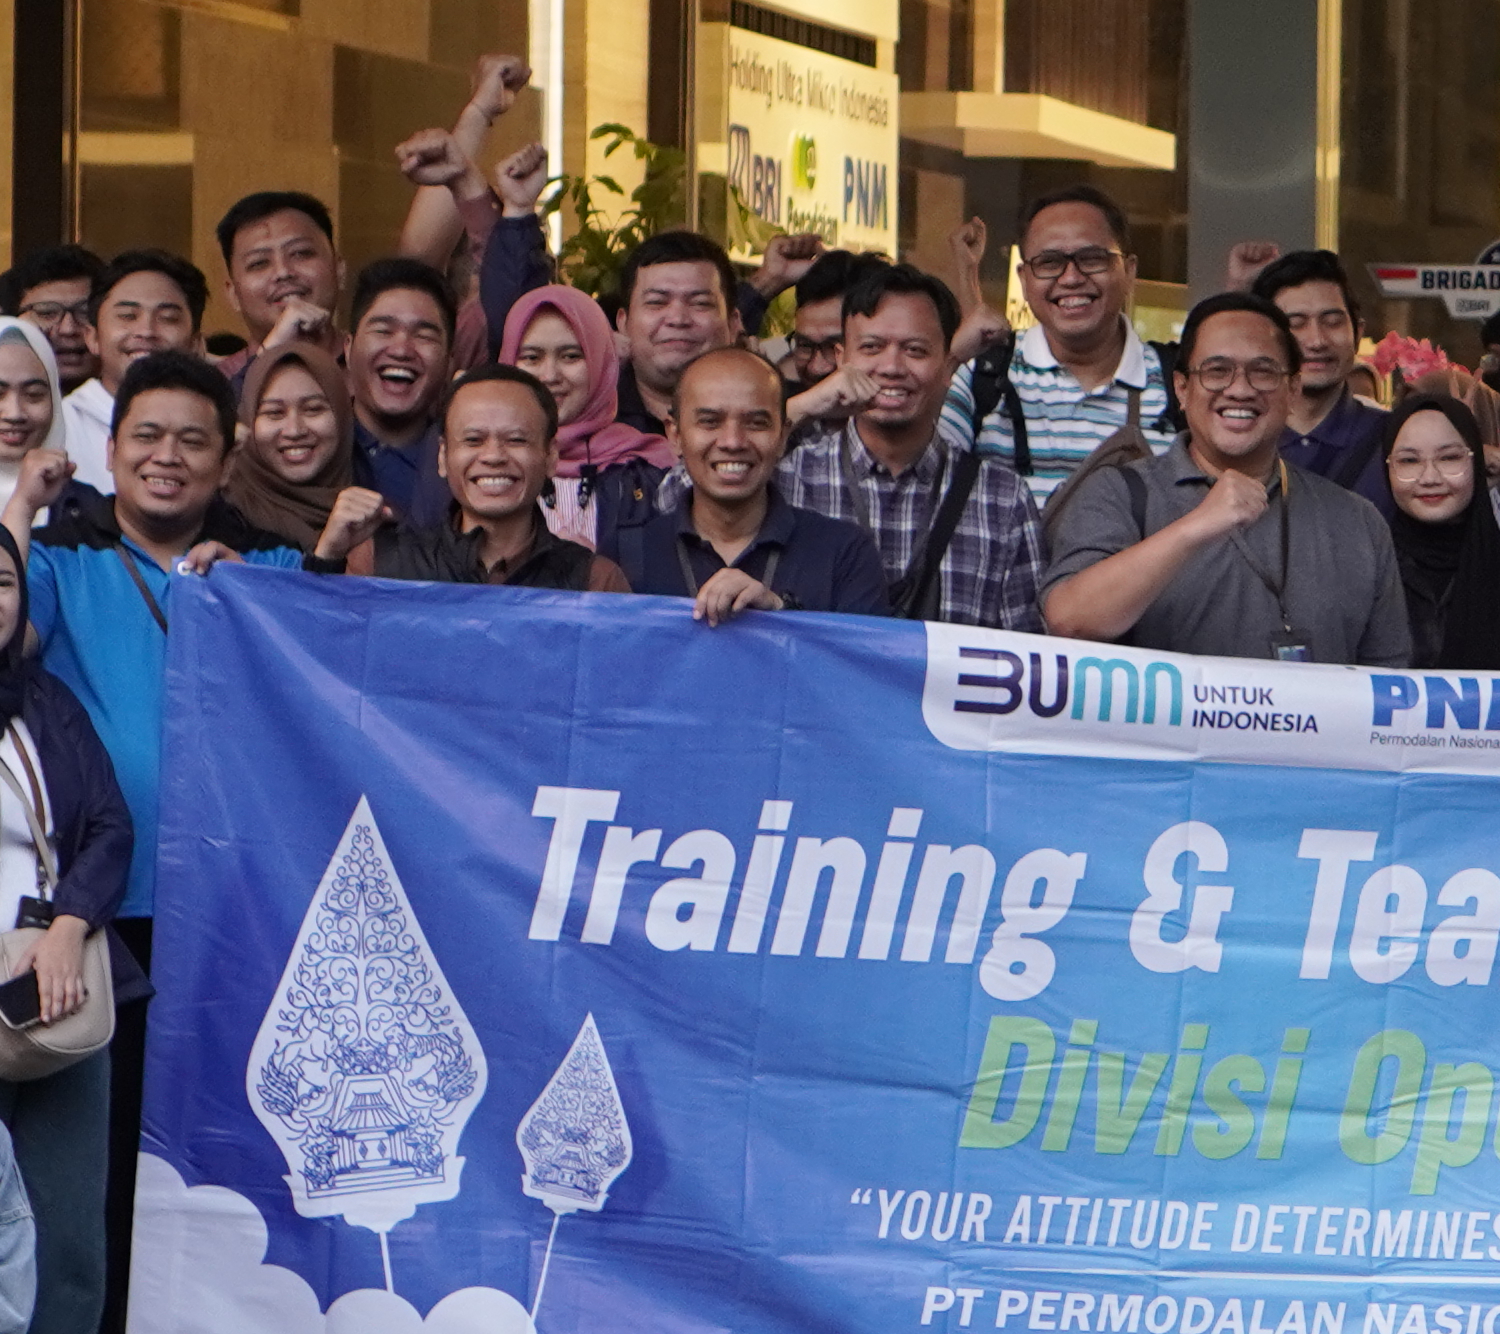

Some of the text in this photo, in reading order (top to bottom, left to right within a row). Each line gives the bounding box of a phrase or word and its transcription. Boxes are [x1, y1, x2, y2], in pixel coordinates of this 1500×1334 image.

[839, 75, 888, 127] Indonesia
[753, 153, 782, 225] BRI
[843, 155, 888, 231] PNM
[1192, 684, 1275, 707] UNTUK
[1192, 709, 1319, 734] INDONESIA
[1370, 731, 1447, 749] Permodalan
[528, 785, 1088, 1002] Training
[1129, 820, 1236, 974] &
[958, 1014, 1311, 1162] Divisi
[851, 1187, 993, 1243] “YOUR
[1003, 1195, 1218, 1252] ATTITUDE
[920, 1286, 983, 1327] PT
